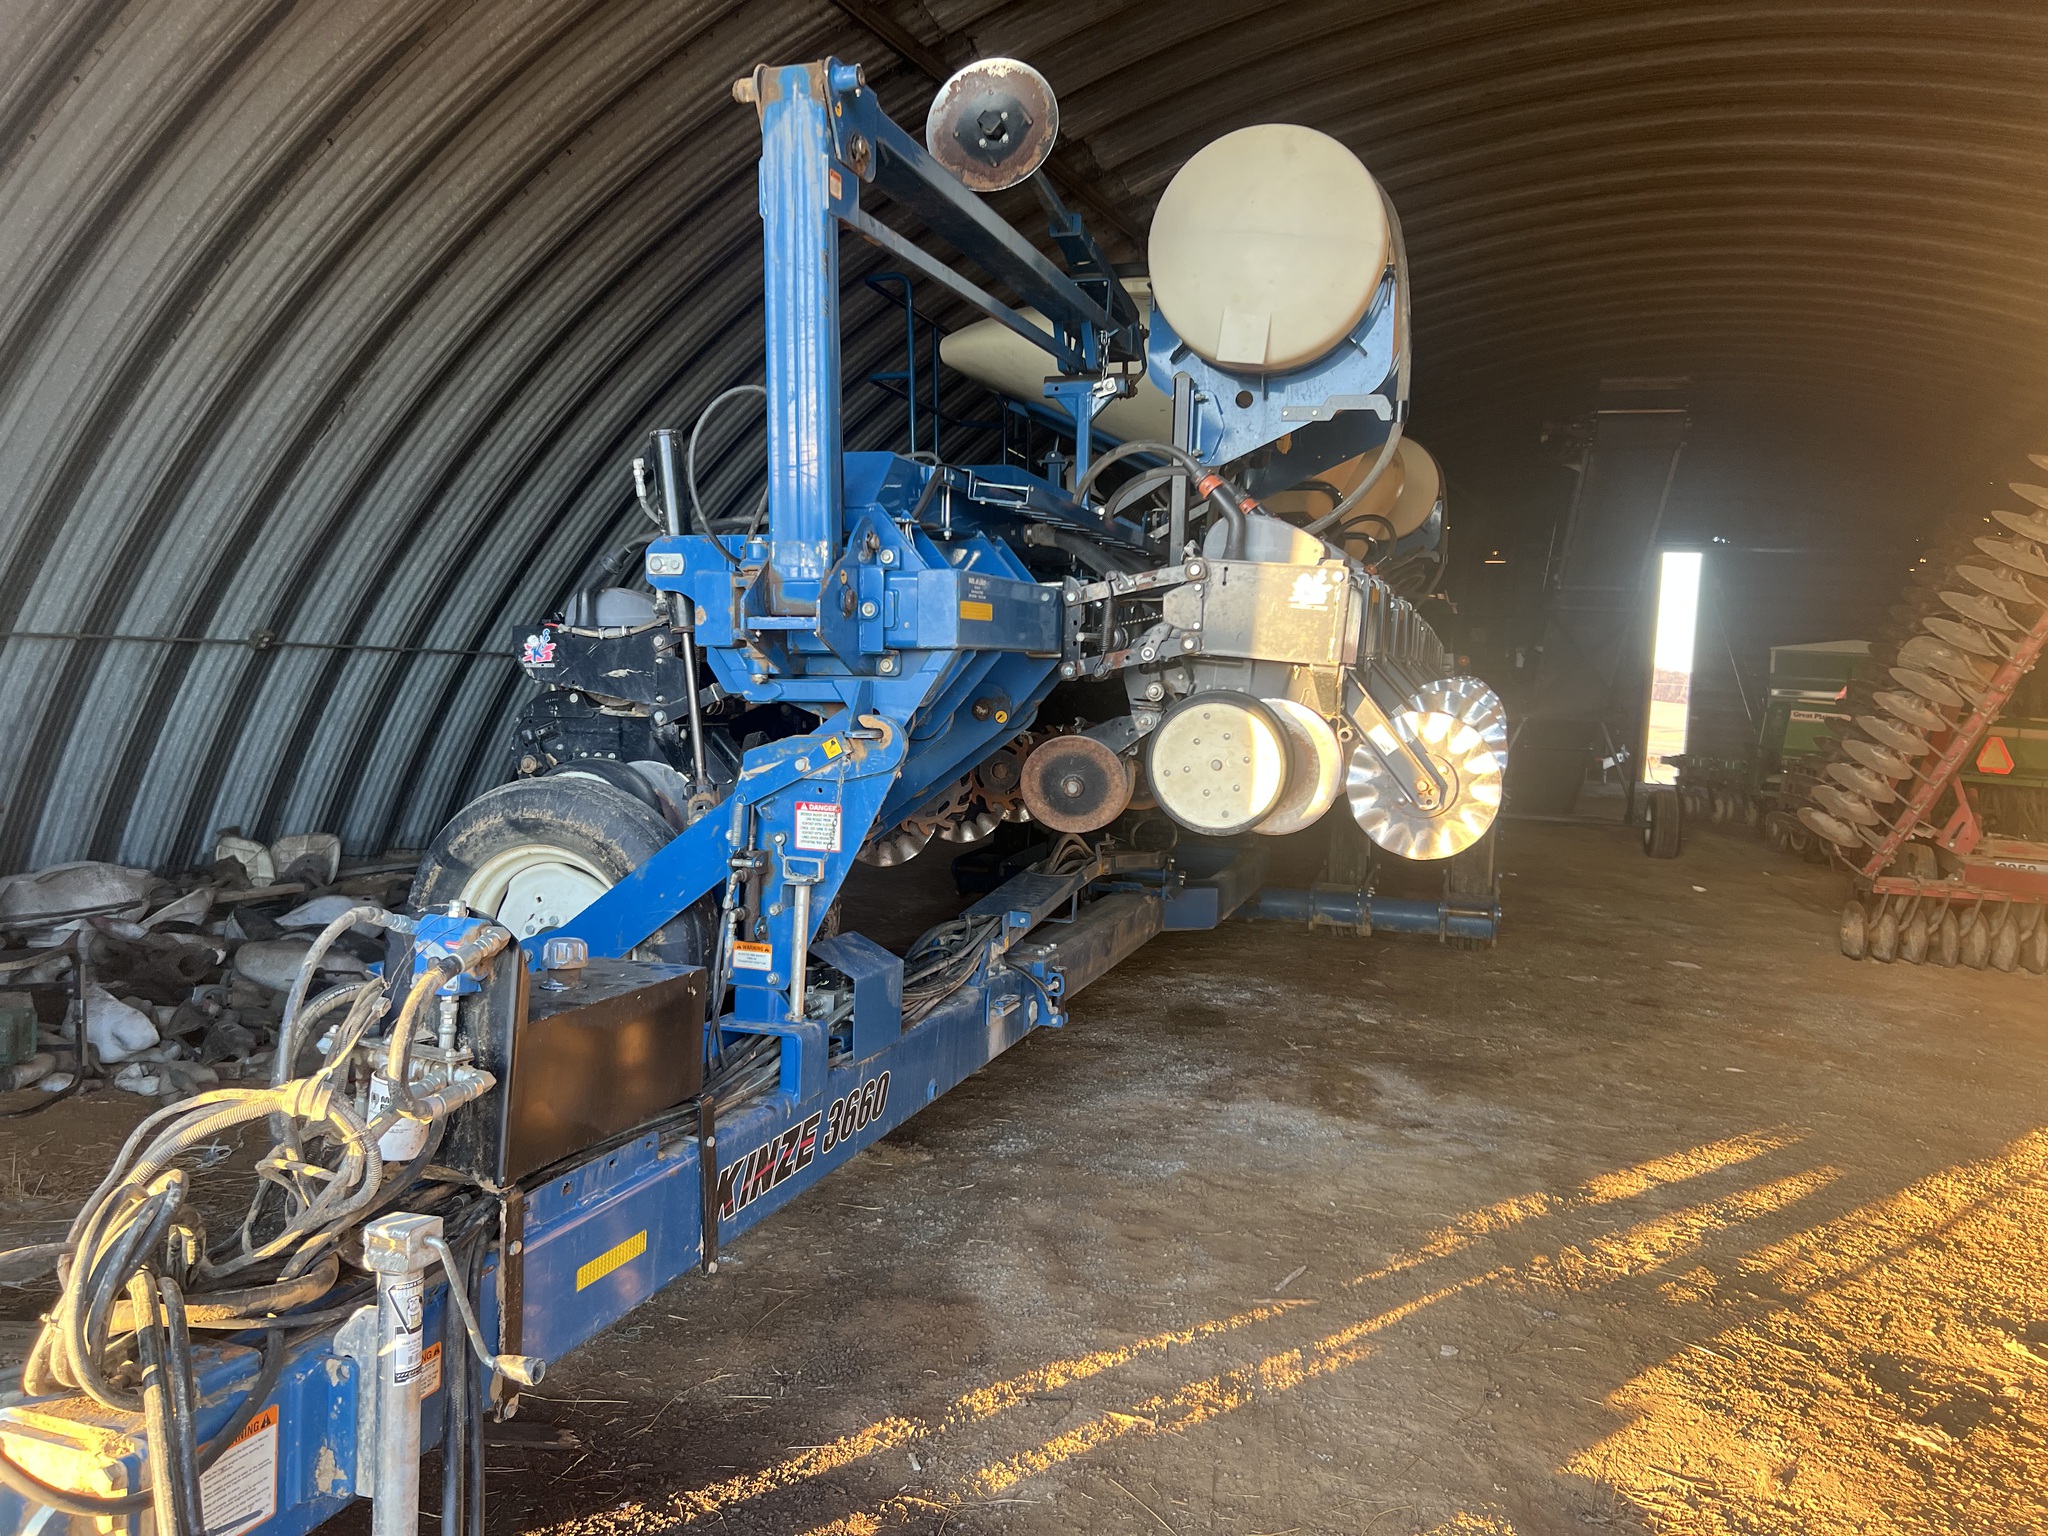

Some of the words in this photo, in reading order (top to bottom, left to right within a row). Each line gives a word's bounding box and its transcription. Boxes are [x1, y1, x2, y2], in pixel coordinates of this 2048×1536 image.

[1793, 711, 1813, 719] Great
[742, 944, 764, 952] WARNING
[717, 1110, 822, 1221] KINZE
[822, 1070, 891, 1154] 3660
